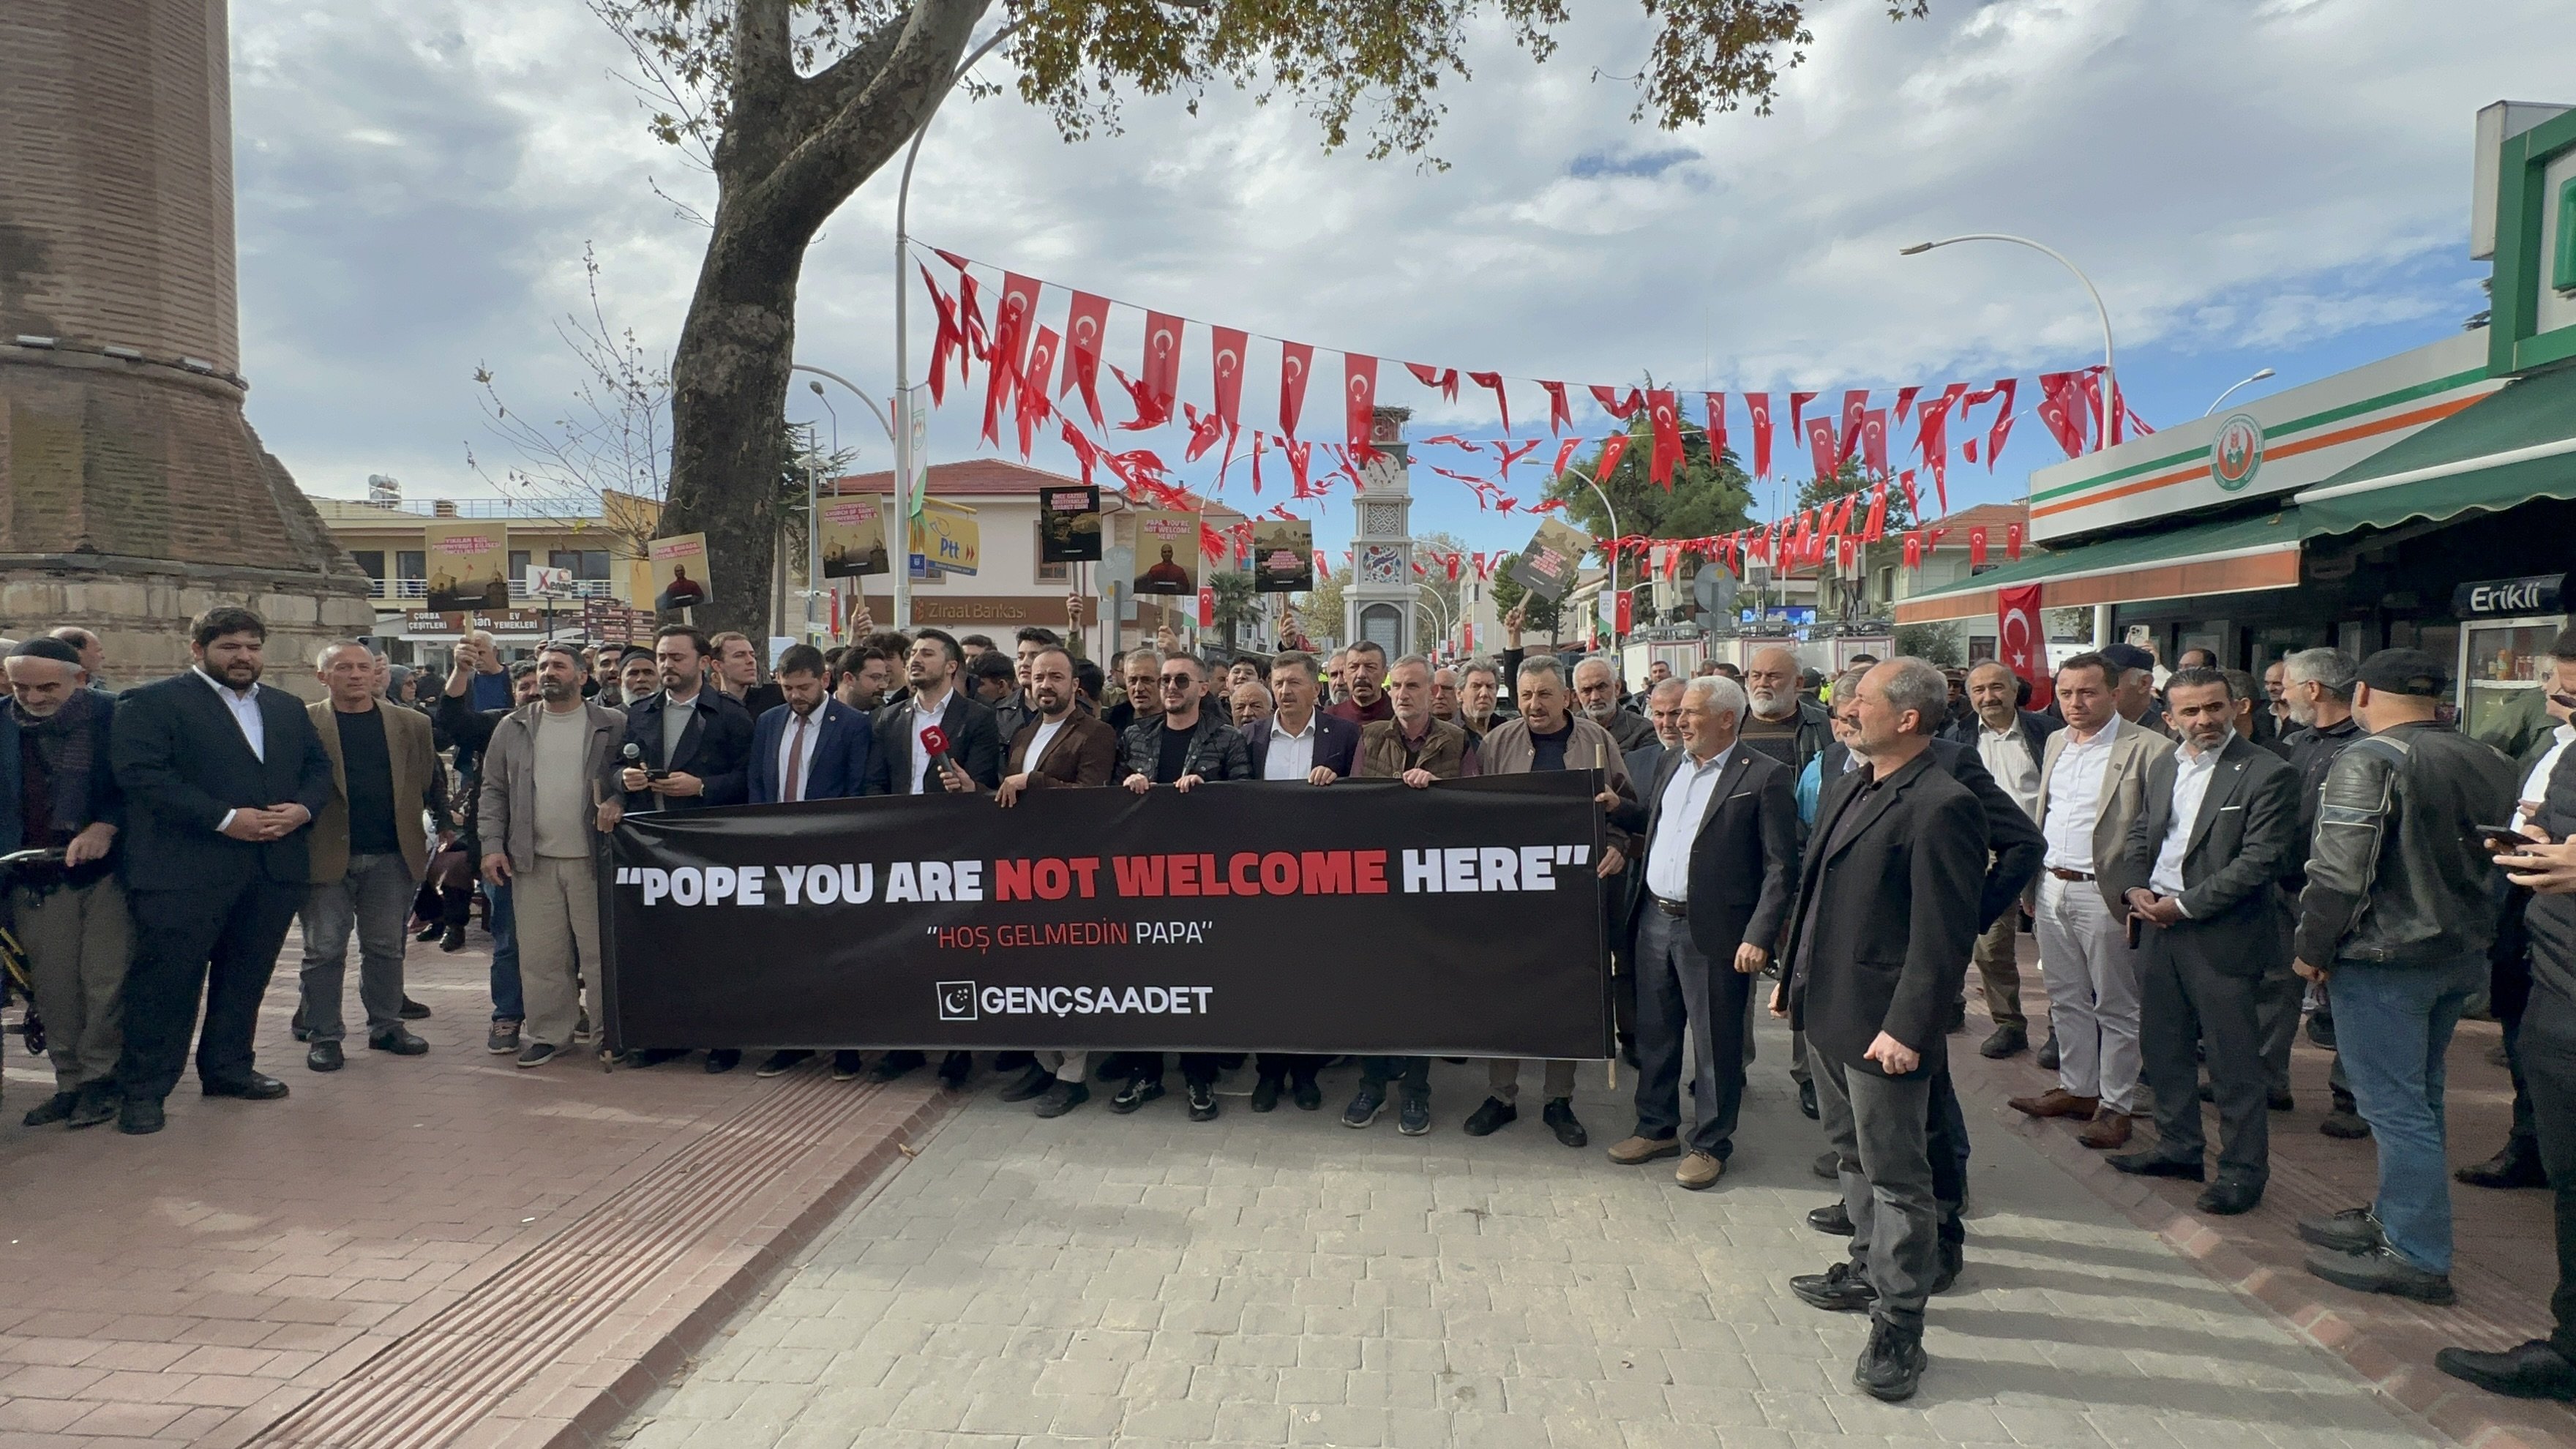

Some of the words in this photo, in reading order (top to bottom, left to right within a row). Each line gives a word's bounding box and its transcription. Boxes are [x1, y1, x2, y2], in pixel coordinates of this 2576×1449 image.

[940, 537, 959, 560] Ptt
[2471, 582, 2540, 611] Erikli
[413, 612, 440, 620] ÇORBA
[509, 612, 520, 620] EV
[929, 602, 970, 618] Ziraat
[973, 602, 1027, 618] Bankası
[408, 621, 447, 630] ÇEŞİTLERİ
[493, 620, 538, 629] YEMEKLERİ
[774, 863, 874, 905] YOU
[885, 860, 984, 904] ARE
[995, 856, 1100, 902] NOT
[1112, 849, 1388, 897] WELCOME
[997, 917, 1128, 947] GELMEDİN
[981, 986, 1213, 1019] GENÇSAADET
